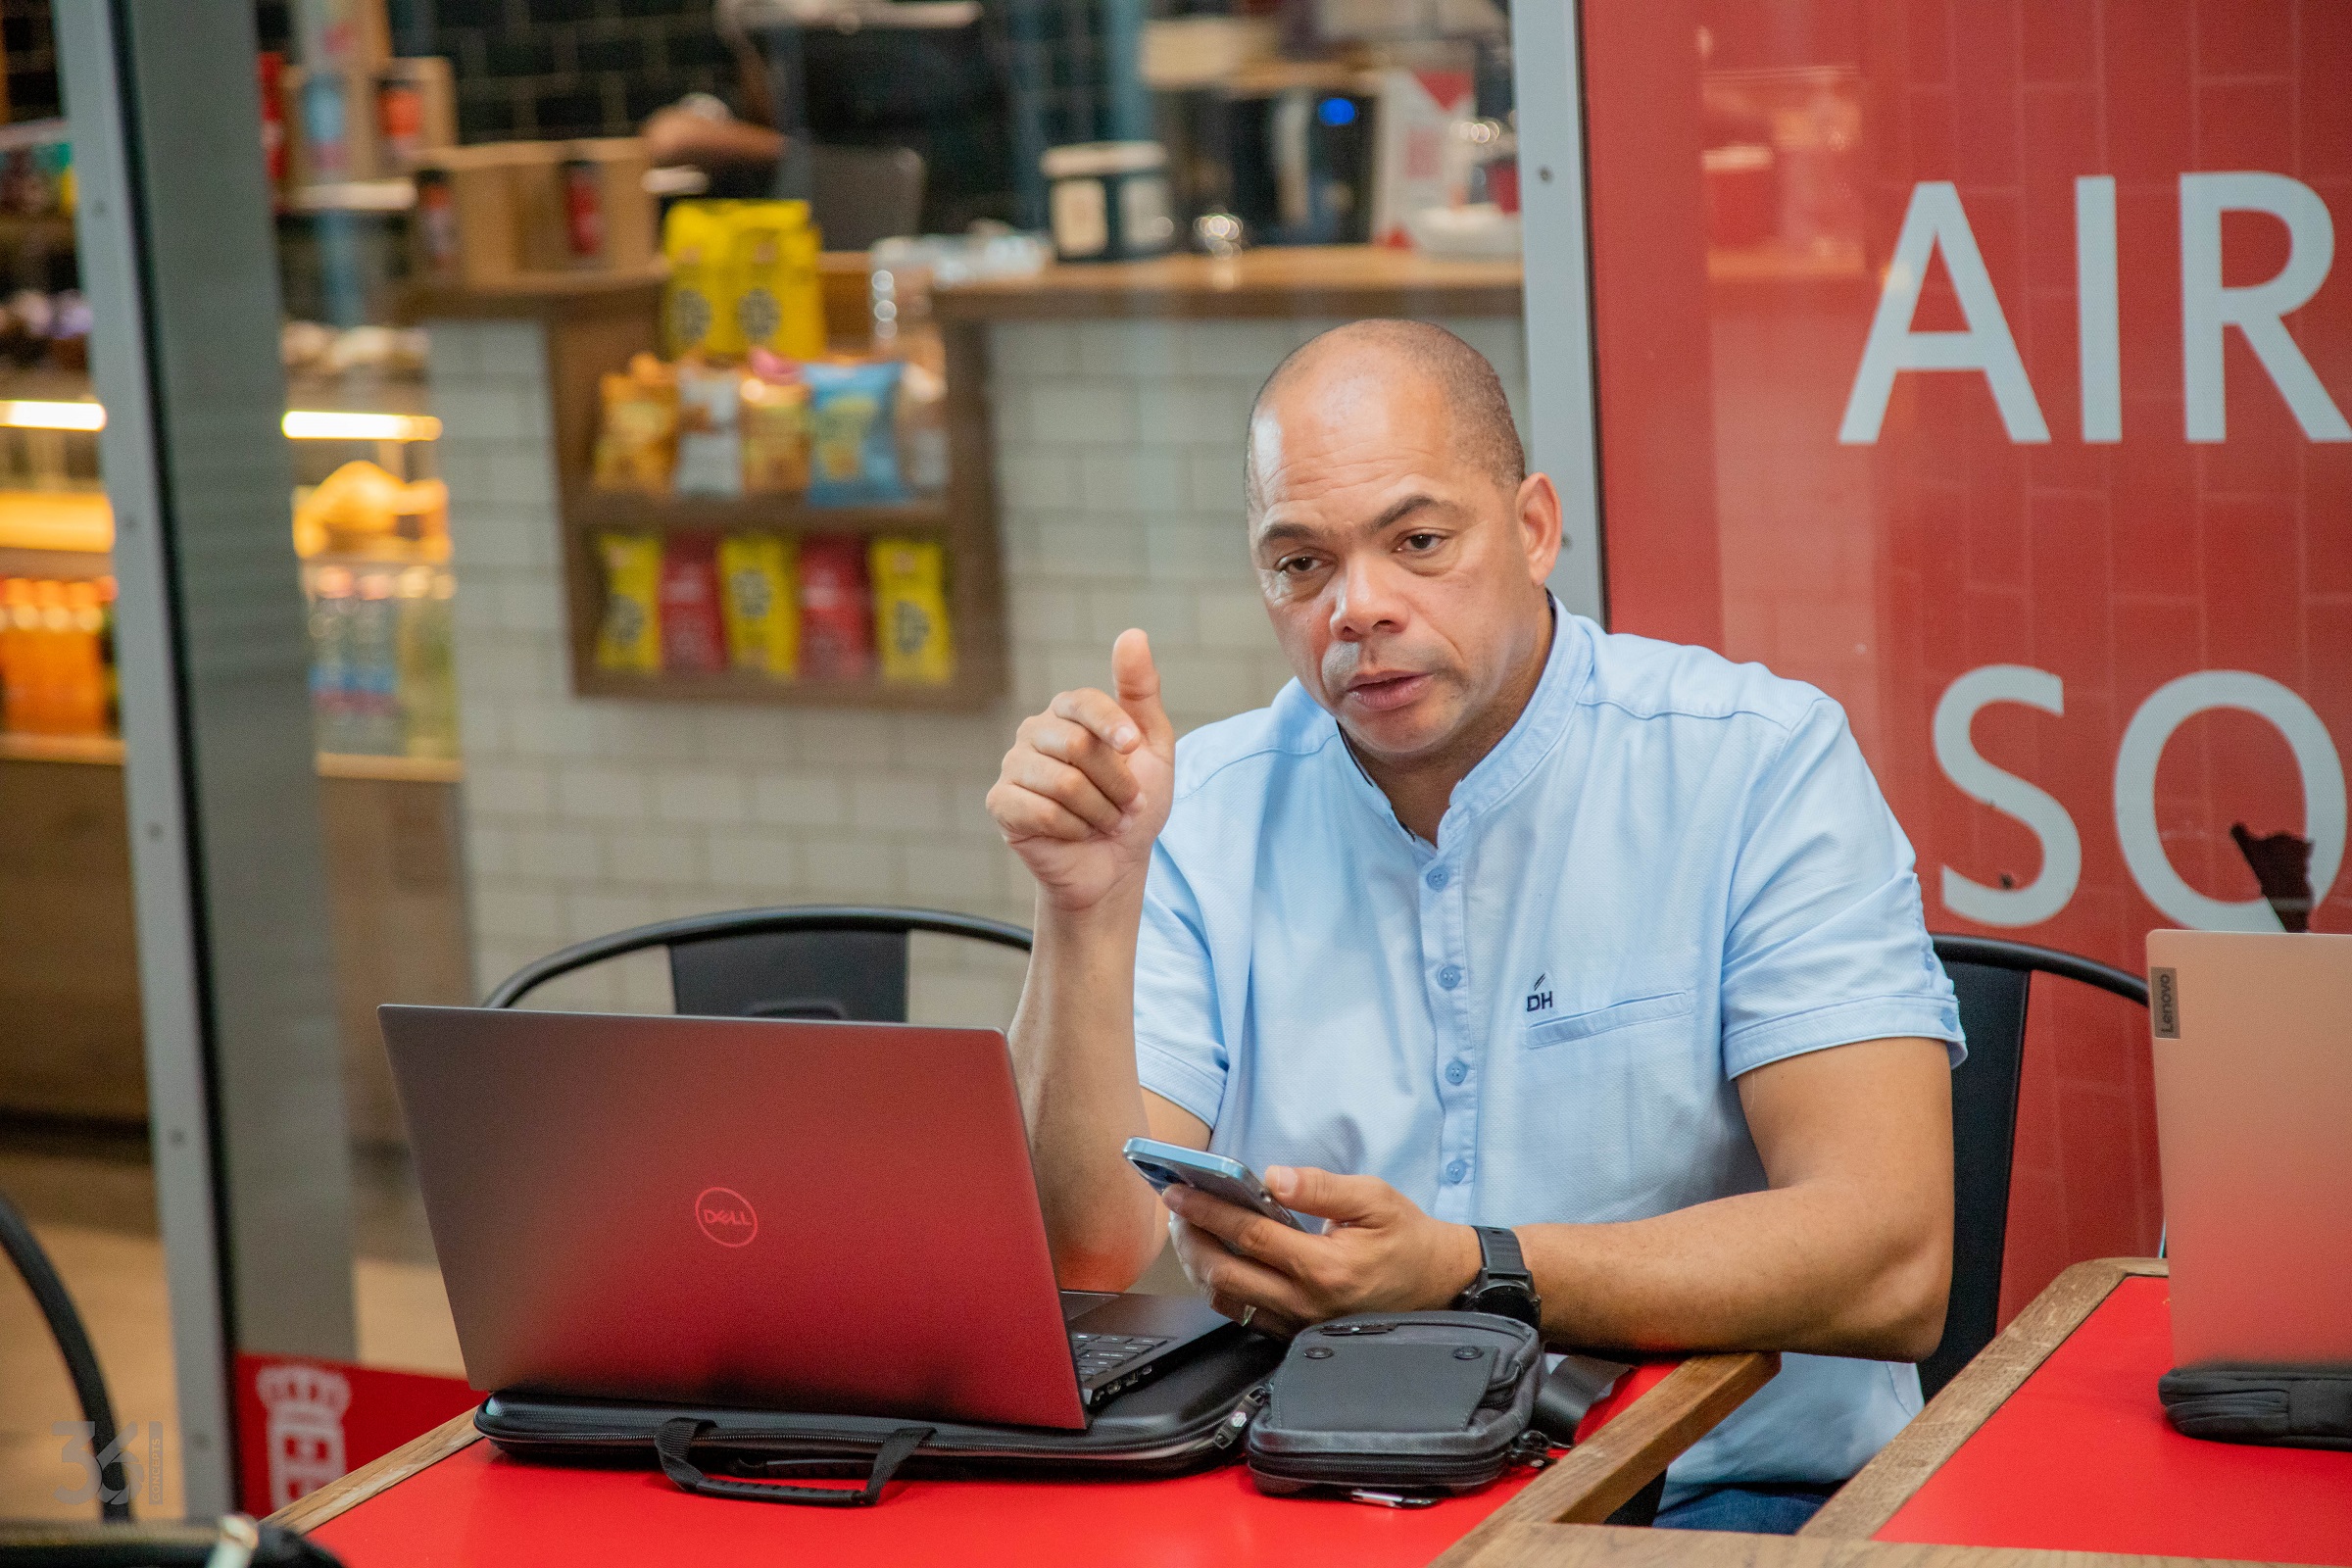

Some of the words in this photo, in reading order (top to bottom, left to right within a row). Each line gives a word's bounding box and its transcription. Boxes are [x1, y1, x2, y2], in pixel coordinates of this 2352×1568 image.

[1838, 171, 2352, 444] AIR
[1526, 990, 1553, 1012] DH
[2160, 973, 2175, 1033] Lenovo
[703, 1208, 753, 1226] DELL
